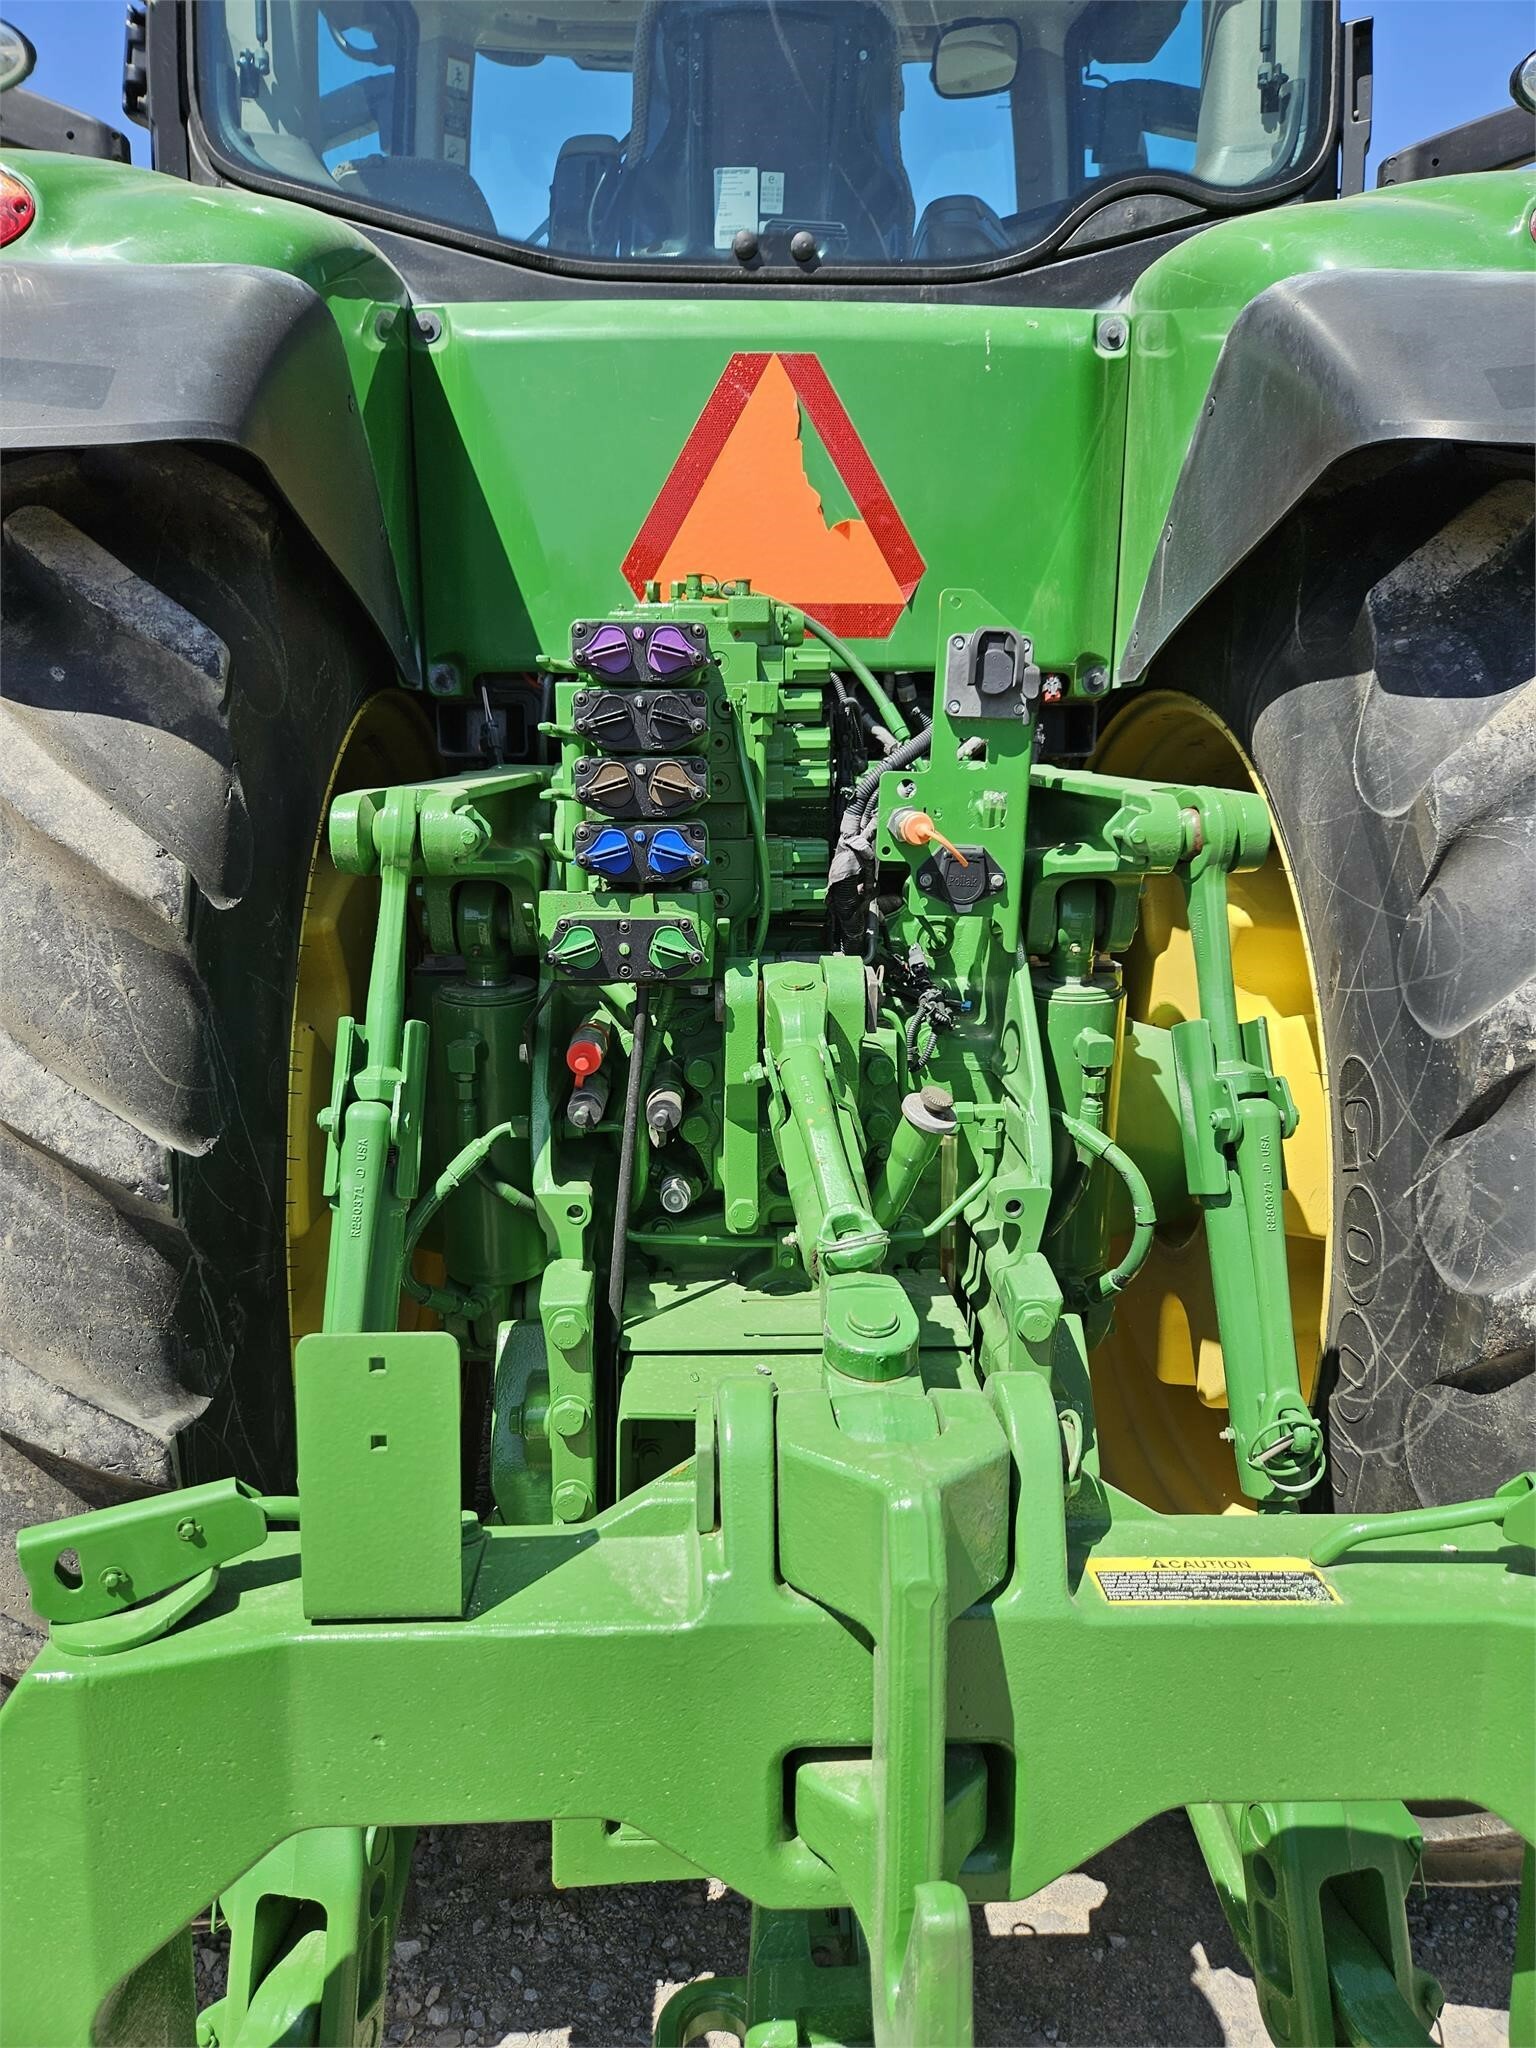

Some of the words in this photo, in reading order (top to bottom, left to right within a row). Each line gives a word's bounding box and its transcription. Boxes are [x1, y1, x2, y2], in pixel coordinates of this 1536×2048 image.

[947, 873, 977, 887] Pollak
[356, 1138, 368, 1161] USA
[1260, 1134, 1271, 1157] USA
[1168, 1559, 1252, 1569] CAUTION
